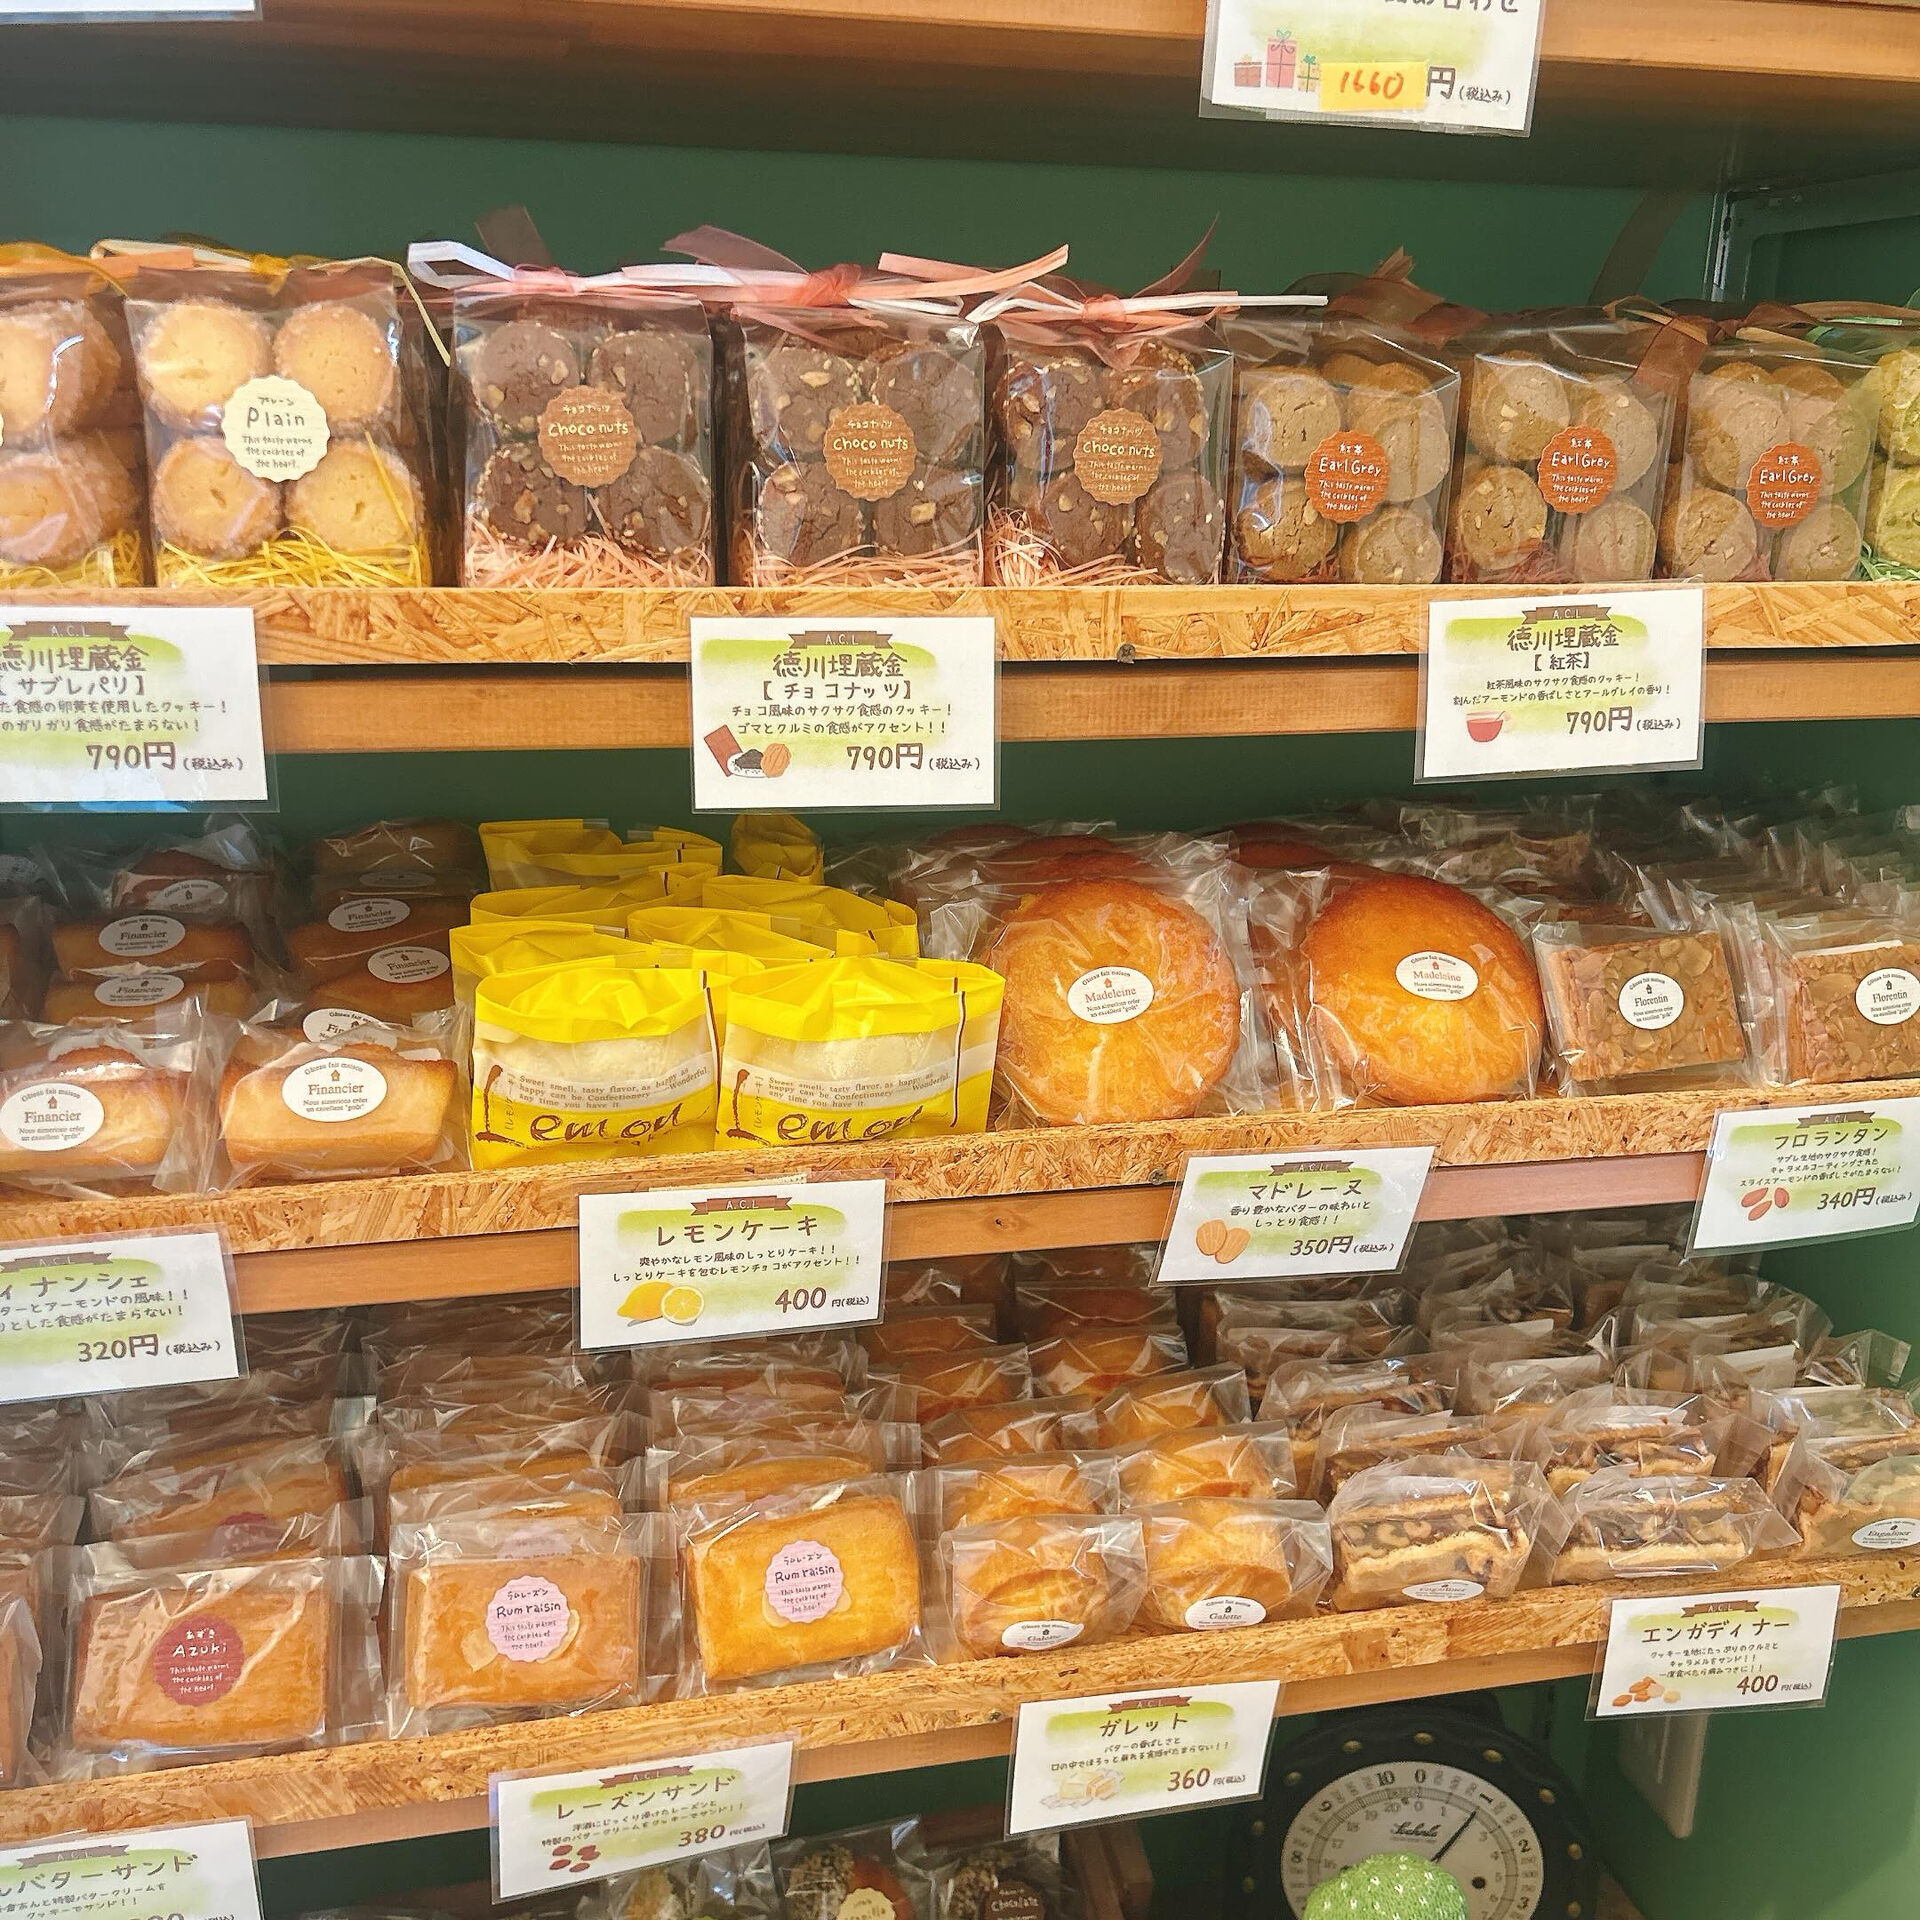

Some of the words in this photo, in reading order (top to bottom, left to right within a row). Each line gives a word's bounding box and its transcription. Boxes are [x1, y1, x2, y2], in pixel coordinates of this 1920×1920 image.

[1340, 71, 1404, 100] 1660
[1427, 66, 1457, 100] 円
[246, 406, 306, 429] Plain
[547, 421, 597, 438] Choco
[598, 420, 630, 436] nuts
[833, 436, 878, 451] Choco
[880, 436, 909, 451] nuts
[1082, 440, 1126, 456] Choco
[1128, 444, 1157, 459] nuts
[1318, 455, 1349, 474] Earl
[1351, 459, 1382, 478] Grey
[1551, 451, 1580, 468] Earl
[1581, 452, 1611, 470] Grey
[1759, 468, 1786, 485] Earl
[1787, 469, 1816, 485] Grey
[1506, 623, 1624, 652] 徳川埋蔵金
[772, 651, 908, 680] 徳川埋蔵金
[1533, 651, 1591, 672] 【紅茶】
[763, 680, 912, 701] 【チョコナッツ】
[1565, 706, 1633, 735] 790円
[86, 741, 177, 771] 790円
[846, 742, 923, 771] 790円
[1412, 970, 1462, 982] Madeleine
[1084, 987, 1137, 1004] Madeleine
[1634, 994, 1669, 1008] Florentin
[1872, 990, 1908, 1004] Florentin
[307, 1083, 365, 1096] Financier
[518, 1074, 546, 1088] Sweet
[549, 1083, 577, 1094] smell,
[581, 1086, 606, 1096] tasty
[609, 1084, 639, 1094] flavor,
[640, 1083, 651, 1092] as
[655, 1073, 678, 1089] happy
[680, 1067, 690, 1077] as
[768, 1076, 794, 1087] Sweet
[854, 1082, 883, 1091] flavor,
[898, 1075, 922, 1088] happy
[518, 1083, 546, 1098] happy
[549, 1091, 568, 1101] can
[587, 1091, 651, 1102] Confectionery
[519, 1092, 535, 1103] any
[538, 1096, 560, 1108] time
[563, 1101, 582, 1110] you
[585, 1100, 608, 1109] have
[768, 1084, 796, 1095] happy
[798, 1089, 816, 1097] can
[833, 1089, 895, 1101] Confectionery
[787, 1094, 808, 1104] time
[811, 1100, 828, 1108] you
[831, 1099, 852, 1108] have
[23, 1110, 82, 1124] Financier
[1773, 1126, 1889, 1151] フロランタン
[1248, 1178, 1363, 1202] マドレーヌ
[1816, 1187, 1877, 1211] 340円
[656, 1215, 819, 1248] レモンケーキ
[1289, 1235, 1354, 1256] 350円
[774, 1286, 827, 1315] 400
[77, 1333, 159, 1363] 320円
[774, 1570, 800, 1584] Rum
[801, 1564, 836, 1578] raisin
[496, 1605, 523, 1620] Rum
[525, 1602, 561, 1614] raisin
[1641, 1618, 1791, 1645] エンガディナー
[172, 1642, 228, 1658] Azuki
[1736, 1674, 1780, 1696] 400
[1099, 1713, 1189, 1738] ガレット
[1167, 1767, 1212, 1792] 360
[1376, 1770, 1396, 1787] 10
[1414, 1768, 1427, 1784] 0
[556, 1775, 737, 1820] レーズンサンド
[677, 1823, 727, 1848] 380
[1517, 1838, 1532, 1853] 2
[1516, 1896, 1530, 1910] 3
